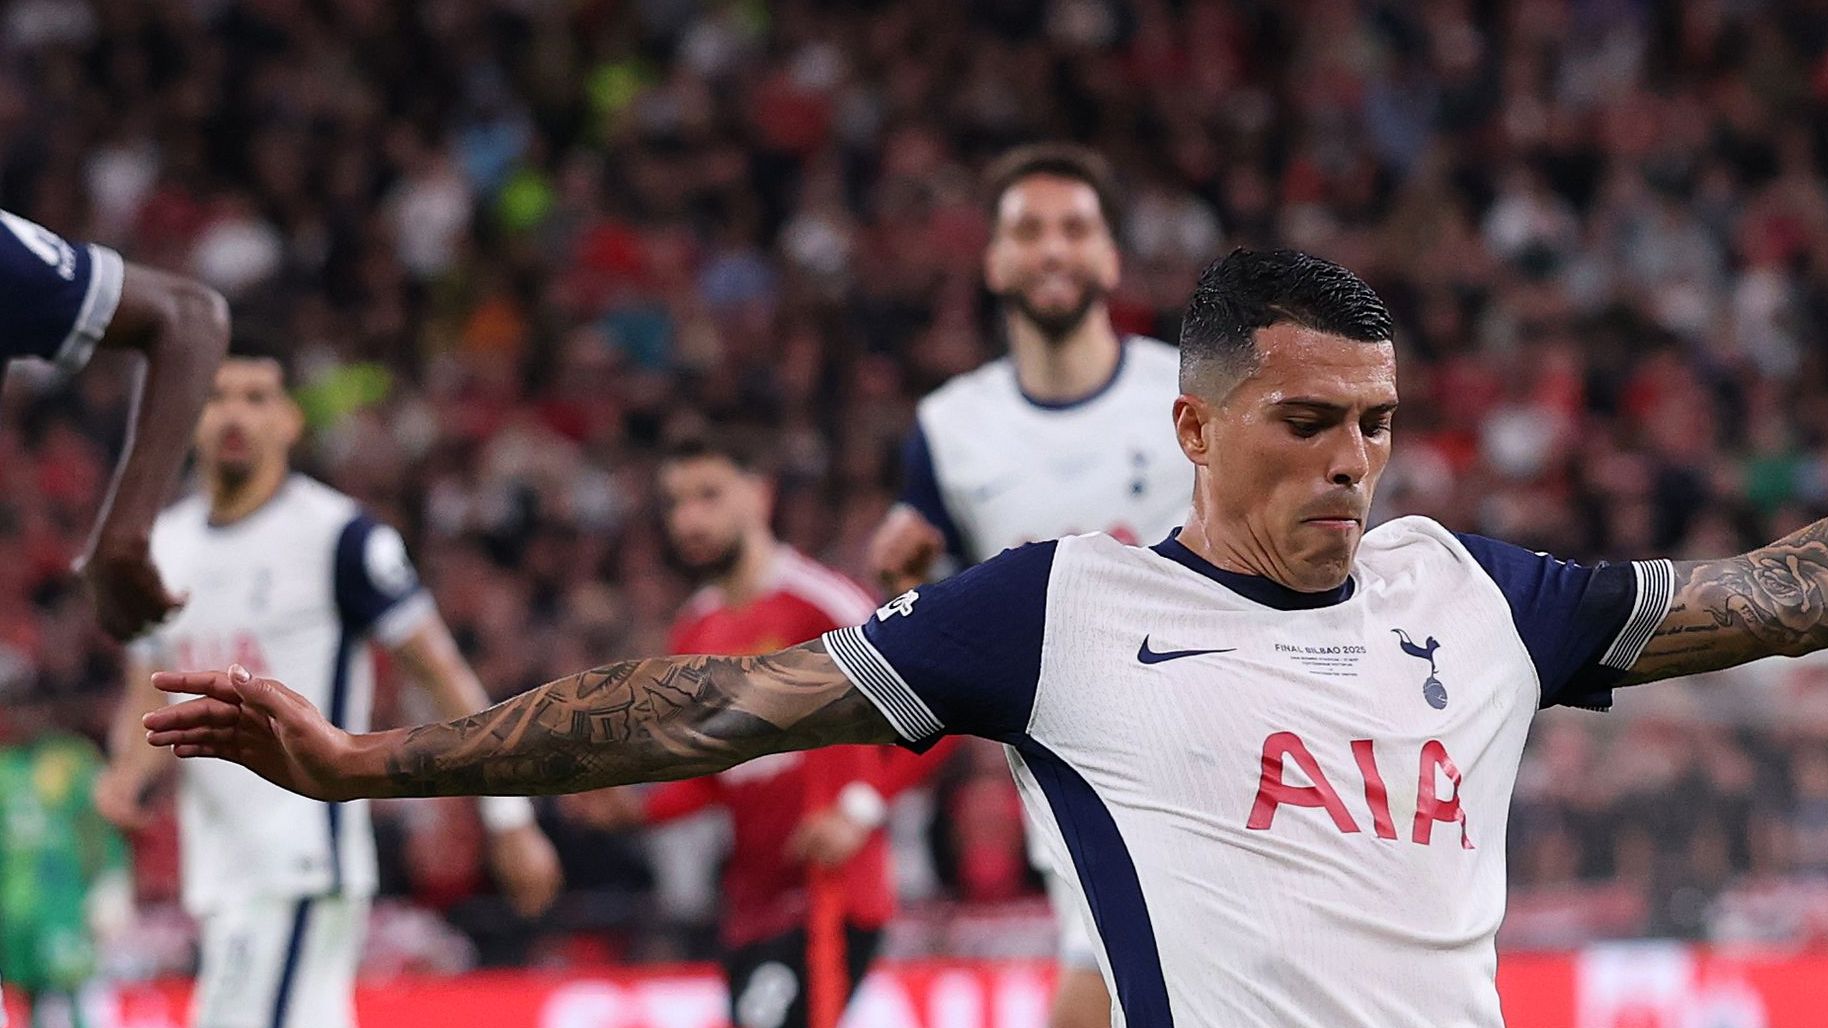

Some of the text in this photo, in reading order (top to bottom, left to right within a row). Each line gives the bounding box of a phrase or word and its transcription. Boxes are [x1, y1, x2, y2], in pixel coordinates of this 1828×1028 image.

[1274, 643, 1367, 655] FINAL BILBAO 2025
[1246, 731, 1477, 851] AIA
